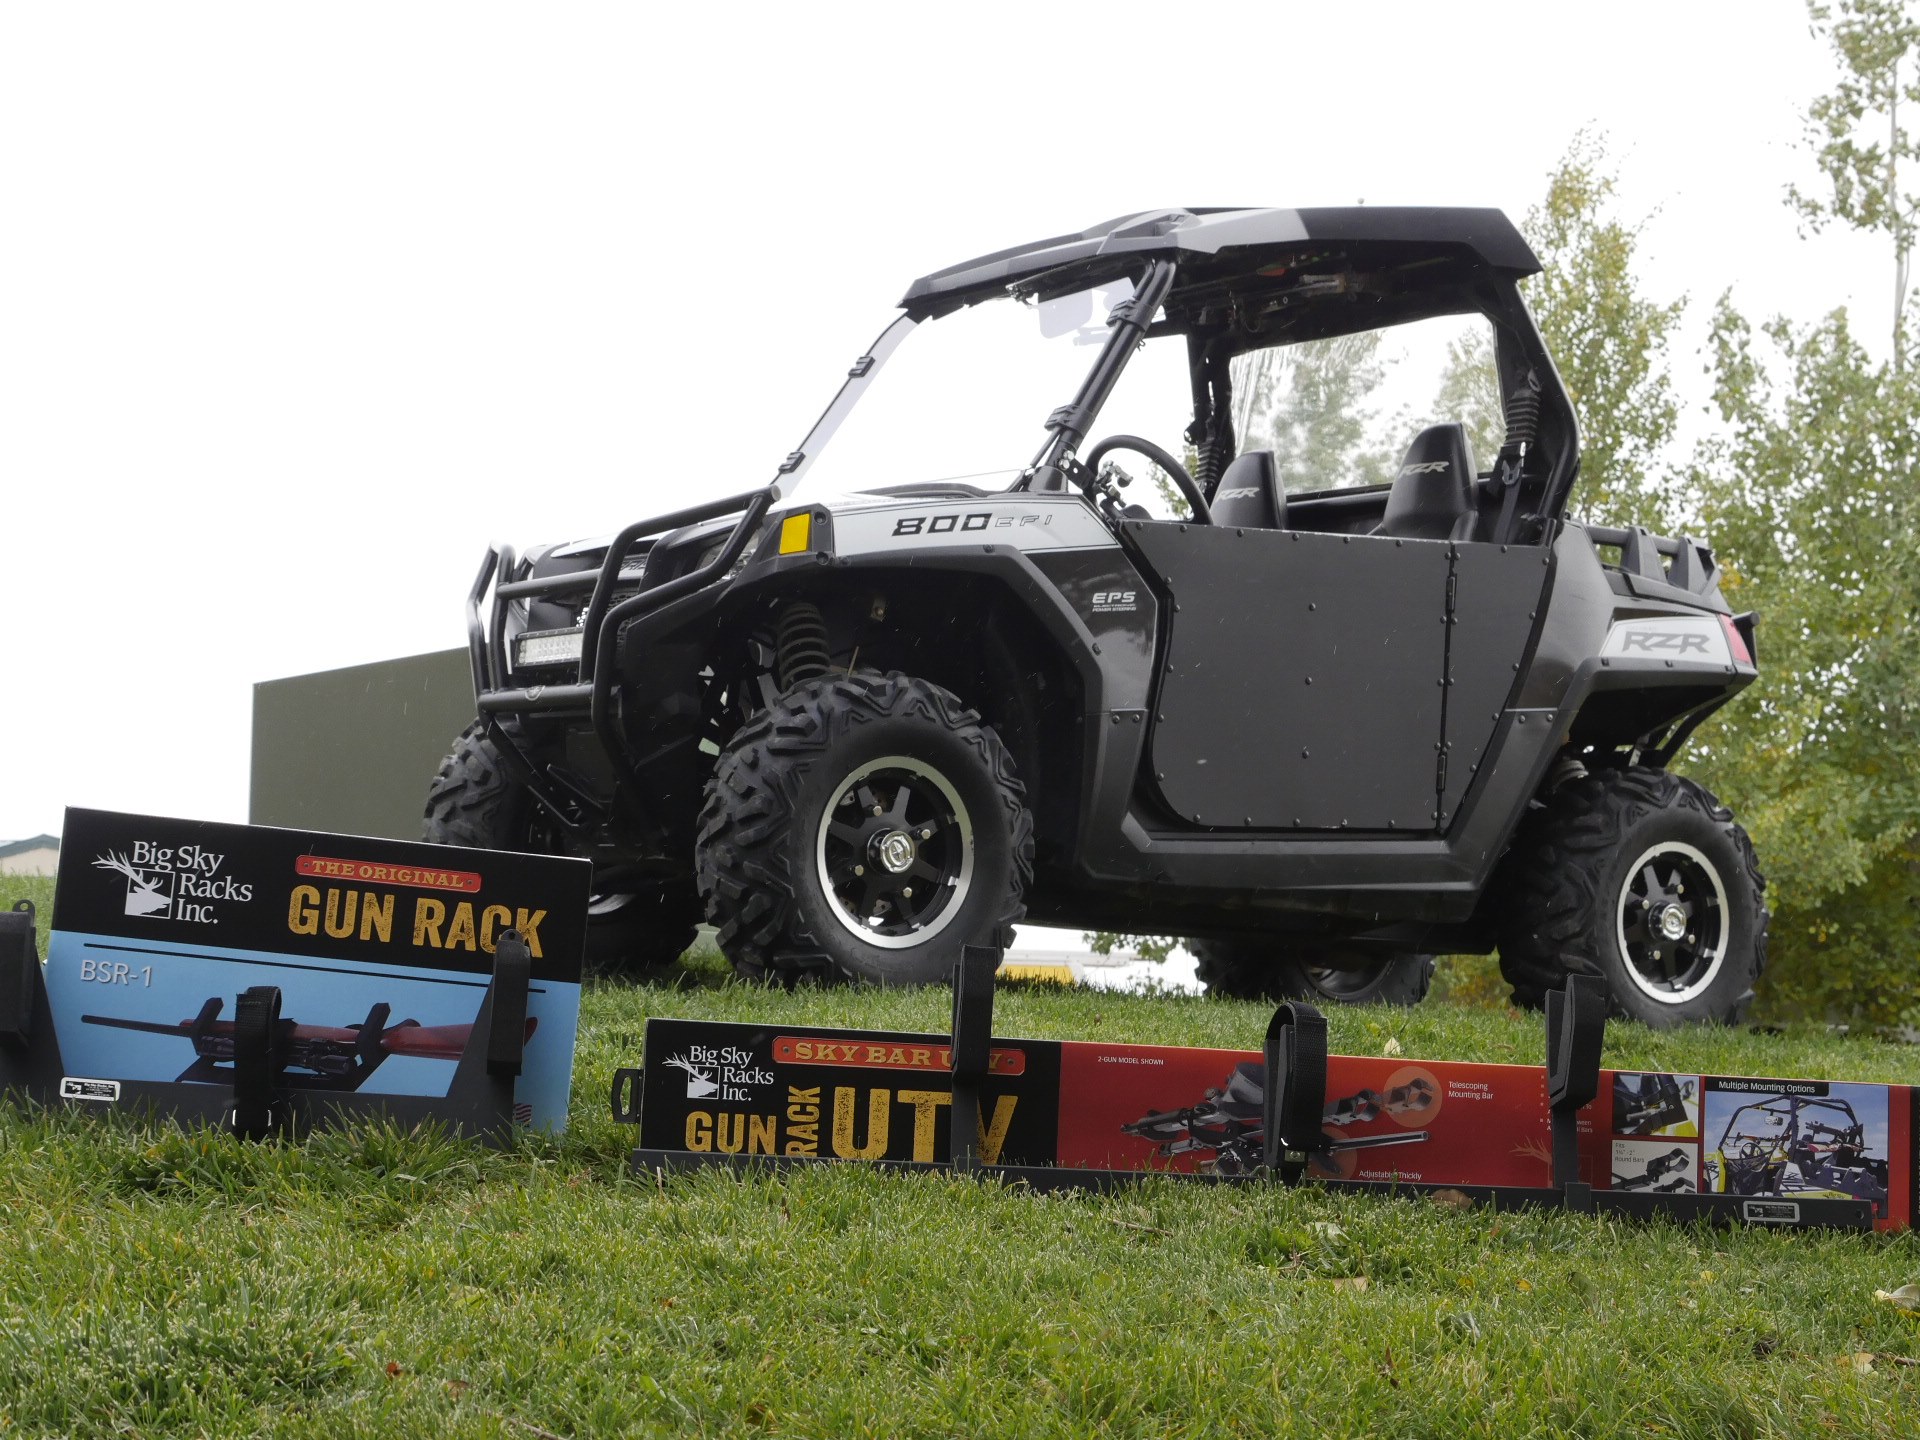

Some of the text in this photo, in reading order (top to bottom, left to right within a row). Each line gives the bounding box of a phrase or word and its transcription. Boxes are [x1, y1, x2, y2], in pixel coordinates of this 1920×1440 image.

[891, 512, 1052, 536] 800 EFI
[1092, 591, 1136, 604] EPS
[1622, 631, 1710, 654] RZR
[132, 840, 224, 877] Big Sky
[312, 860, 464, 888] THE ORIGINAL
[178, 872, 253, 902] Racks
[176, 898, 218, 924] Inc.
[288, 884, 547, 958] GUN RACK
[80, 959, 153, 988] BSR-1
[690, 1045, 753, 1068] Big Sky
[795, 1042, 860, 1062] SKY
[864, 1047, 931, 1066] BAR
[1118, 1057, 1139, 1065] MODEL
[1140, 1058, 1164, 1066] SHOWN
[723, 1066, 775, 1085] Racks
[1449, 1081, 1488, 1091] Telescoping
[1718, 1080, 1815, 1094] Multiple Mounting Options
[722, 1084, 752, 1101] Inc.
[1448, 1090, 1494, 1100] Mounting Bar
[685, 1111, 777, 1155] GUN
[785, 1085, 821, 1157] RACK
[832, 1086, 1018, 1165] UTV
